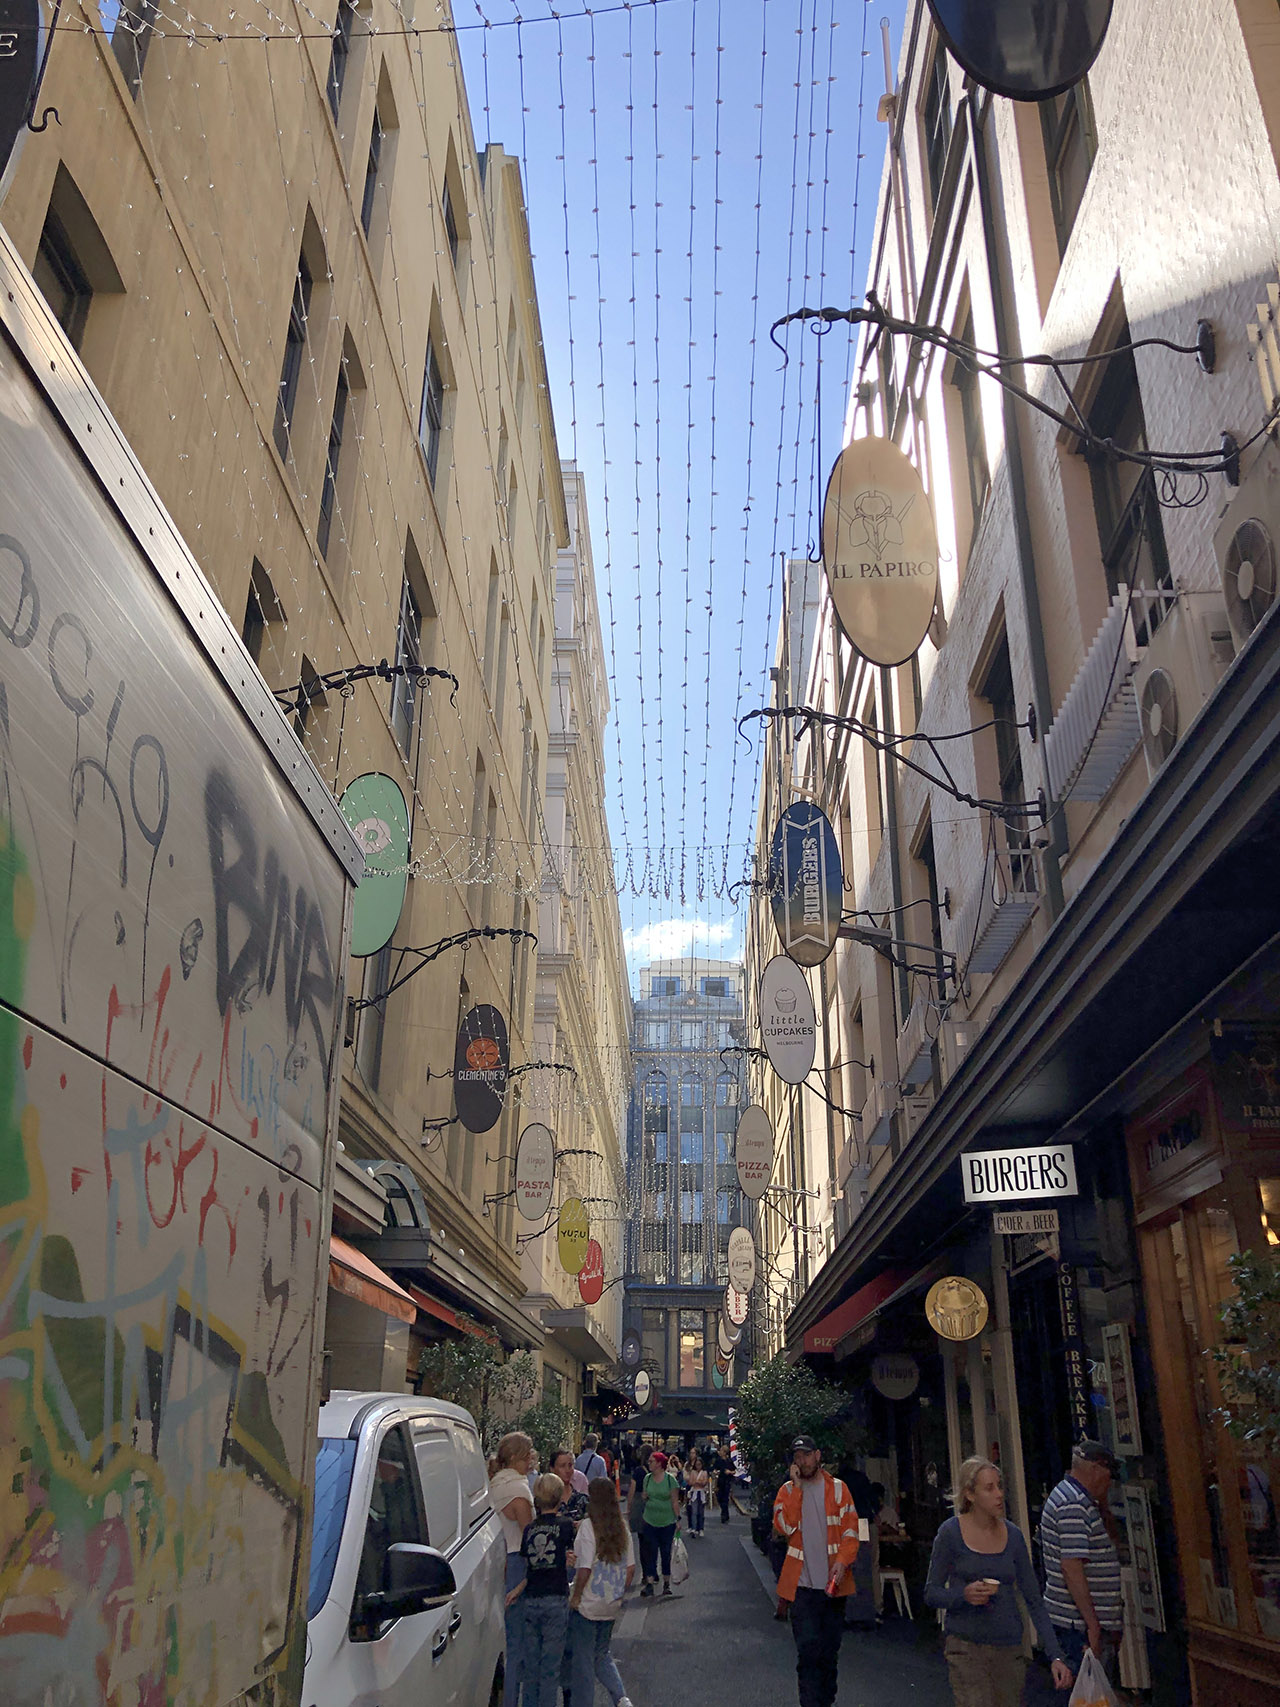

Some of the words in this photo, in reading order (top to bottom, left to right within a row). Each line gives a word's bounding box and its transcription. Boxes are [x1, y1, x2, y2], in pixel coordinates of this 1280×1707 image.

[834, 564, 853, 579] IL
[860, 561, 934, 578] PAPIRO
[802, 837, 821, 926] BURGERS
[770, 1014, 805, 1025] little
[764, 1026, 814, 1037] CUPCAKES
[458, 1069, 505, 1081] CLEMENTINE'S
[738, 1161, 770, 1171] PIZZA
[969, 1152, 1068, 1194] BURGERS
[517, 1180, 551, 1190] PASTA
[525, 1191, 542, 1199] BAR
[997, 1216, 1024, 1231] CIDER
[1033, 1214, 1055, 1230] BEER
[560, 1230, 586, 1238] YUZU
[1060, 1262, 1077, 1337] COFFEE
